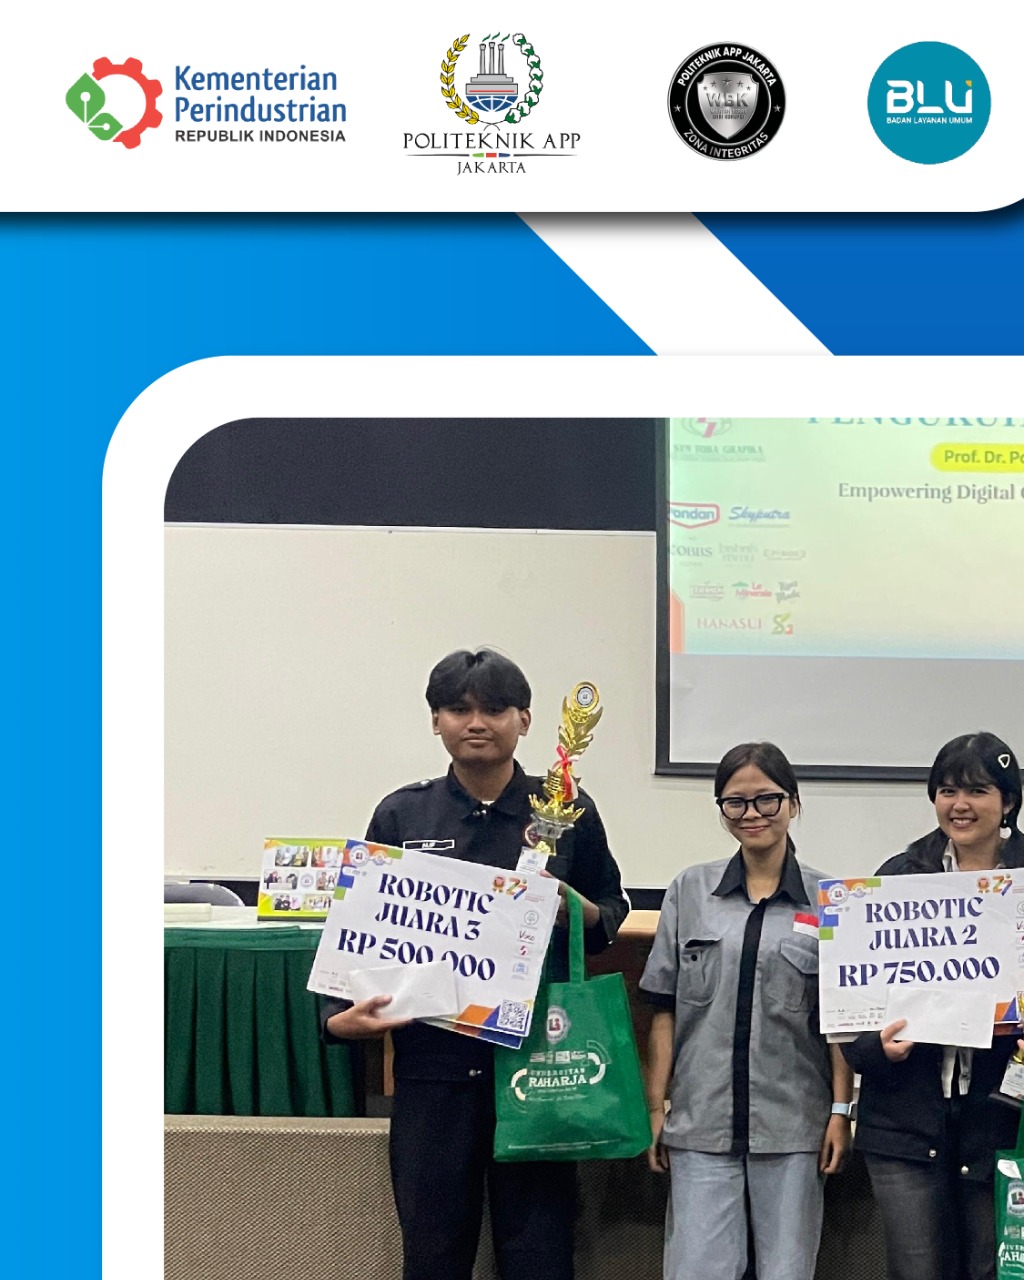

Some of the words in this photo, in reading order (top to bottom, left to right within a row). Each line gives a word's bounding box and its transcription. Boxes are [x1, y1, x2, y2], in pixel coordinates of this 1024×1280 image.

[943, 449, 981, 464] Prof.
[984, 450, 1007, 464] Dr.
[838, 482, 952, 503] Empowering
[956, 484, 1016, 504] Digital
[377, 873, 495, 915] ROBOTIC
[375, 902, 460, 939] JUARA
[464, 920, 482, 941] 3
[865, 896, 984, 923] ROBOTIC
[868, 926, 958, 951] JUARA
[962, 924, 978, 945] 2
[337, 928, 377, 957] RP
[379, 937, 496, 981] 500000
[838, 963, 878, 987] RP
[883, 956, 1001, 984] 750.000
[528, 1074, 588, 1088] RAHARJA
